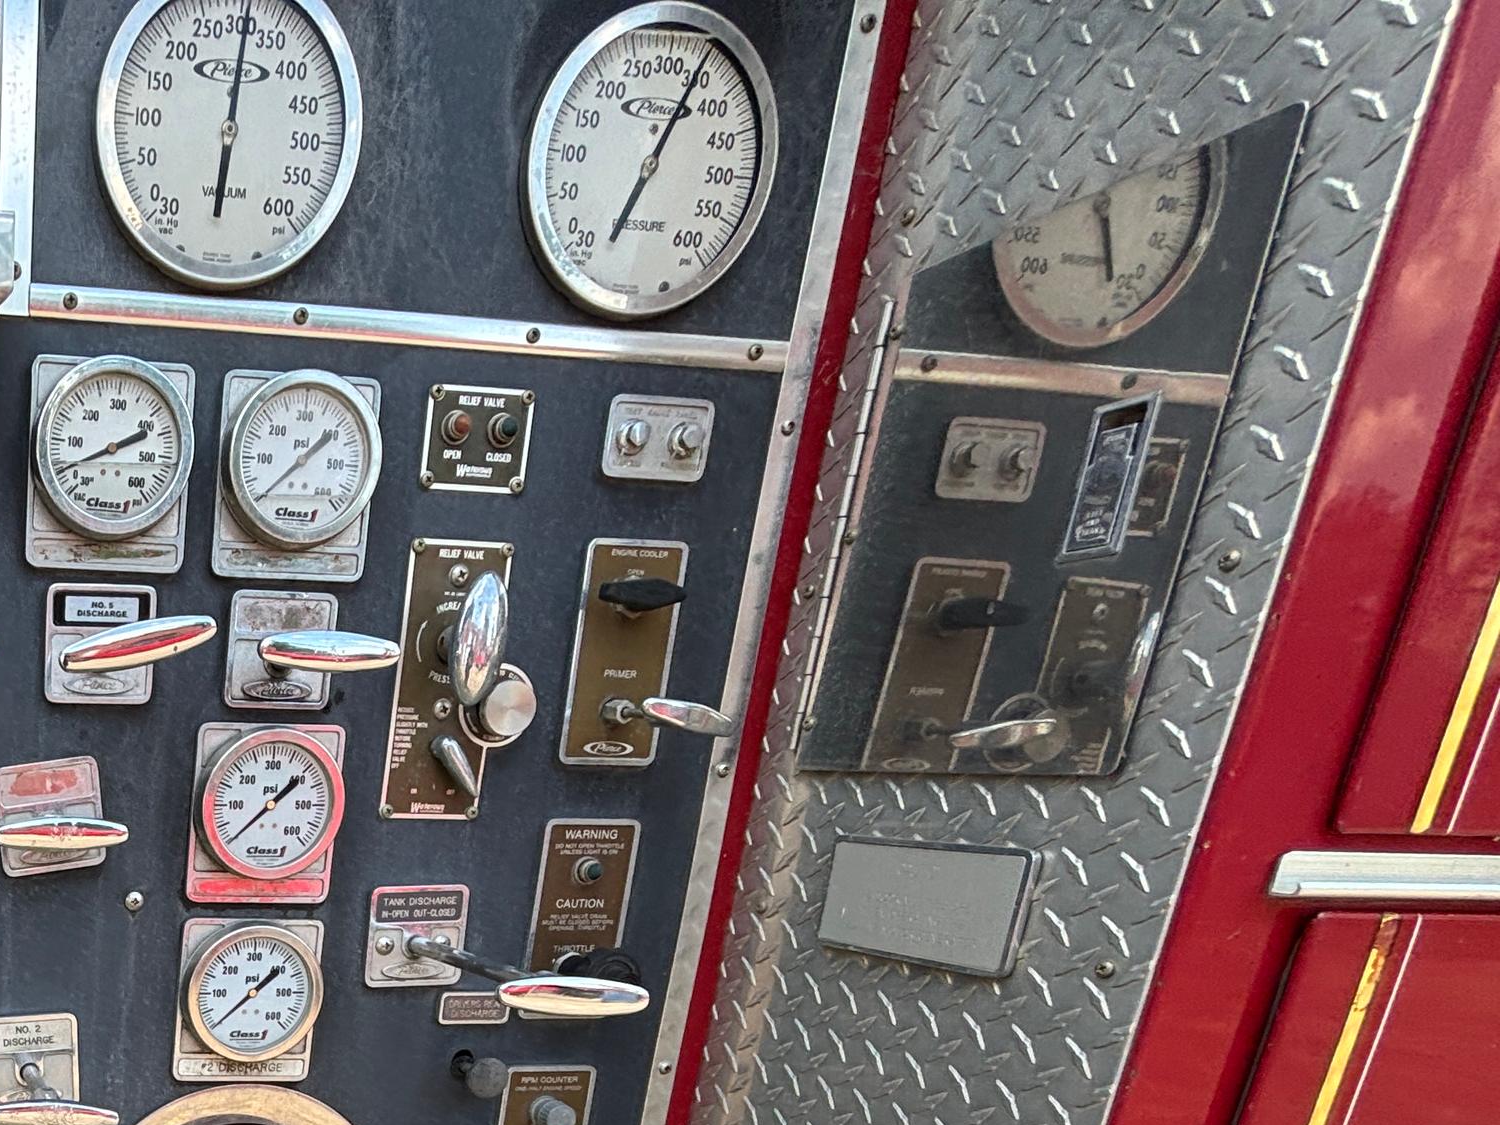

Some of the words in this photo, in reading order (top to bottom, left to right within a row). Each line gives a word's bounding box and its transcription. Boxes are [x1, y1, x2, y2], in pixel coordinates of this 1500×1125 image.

[192, 18, 224, 39] 250
[256, 29, 286, 50] 350
[165, 41, 197, 62] 200
[275, 60, 307, 81] 400
[622, 58, 652, 79] 250
[653, 56, 684, 76] 300
[147, 70, 173, 92] 150
[595, 80, 627, 101] 200
[289, 130, 321, 152] 500
[706, 131, 735, 151] 450
[560, 143, 586, 163] 100
[282, 165, 312, 186] 550
[159, 196, 179, 216] 30
[262, 197, 294, 218] 600
[694, 199, 722, 218] 550
[272, 225, 285, 236] psi
[672, 230, 703, 249] 600
[109, 398, 127, 411] 300
[459, 394, 481, 406] RELIEF
[483, 397, 505, 408] VALVE
[443, 449, 462, 460] OPEN
[485, 452, 512, 463] CLOSED
[326, 458, 344, 471] 500
[127, 476, 145, 489] 600
[611, 548, 638, 558] ENGINE
[639, 549, 669, 559] COOLER
[91, 601, 109, 610] NO.
[76, 608, 128, 619] DISCHARGE
[603, 669, 638, 679] PRIMER
[565, 829, 619, 840] WARNING
[383, 897, 406, 906] TANK
[409, 896, 457, 906] DISCHARGE
[555, 898, 605, 909] CAUTION
[381, 909, 409, 918] IN-OPEN
[413, 908, 456, 918] OUT-CLOSED
[553, 944, 596, 953] THROTTLE
[245, 973, 260, 985] psi
[15, 1025, 33, 1035] NO.
[34, 1025, 42, 1034] 2
[3, 1035, 55, 1047] DISCHARGE
[219, 1062, 283, 1073] DISCHARGE
[540, 1075, 579, 1084] COUNTER
